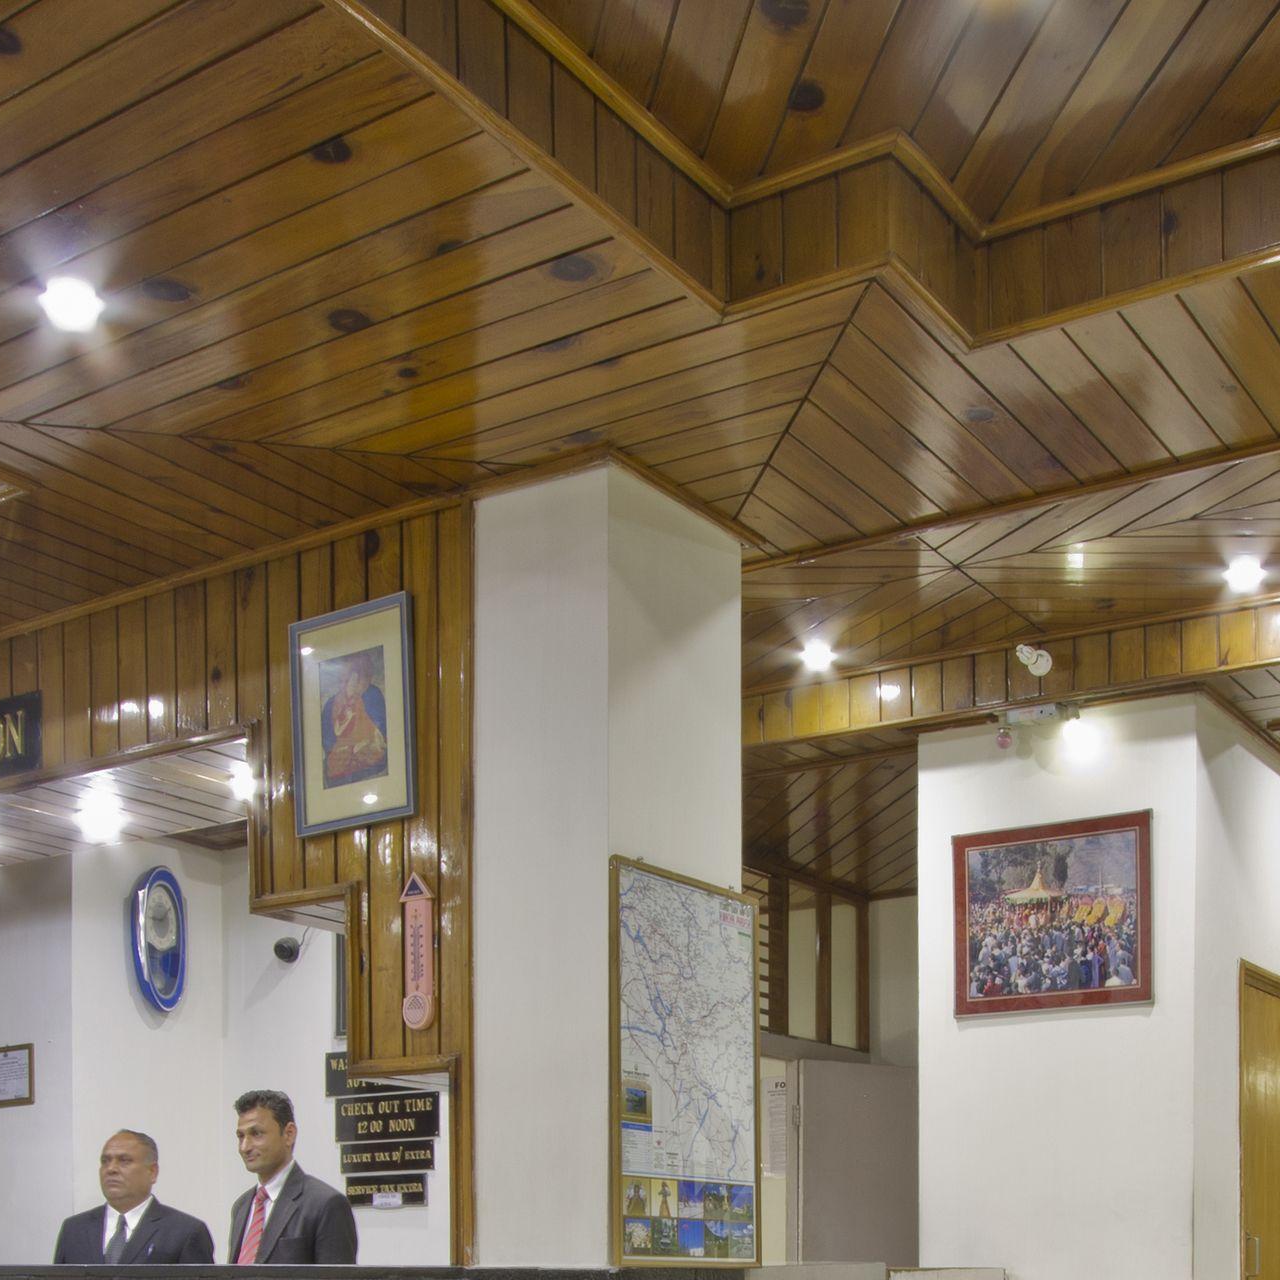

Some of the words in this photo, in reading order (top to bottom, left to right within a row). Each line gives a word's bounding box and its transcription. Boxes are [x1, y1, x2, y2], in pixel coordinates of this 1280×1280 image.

[341, 1102, 374, 1117] CHECK
[378, 1100, 400, 1114] OUT
[404, 1097, 433, 1112] TIME
[388, 1118, 416, 1133] NOON
[343, 1153, 372, 1163] LUXURY
[375, 1151, 390, 1161] TAX
[404, 1150, 431, 1160] EXTRA
[347, 1184, 378, 1195] SERVICE
[397, 1183, 424, 1193] EXTRA
